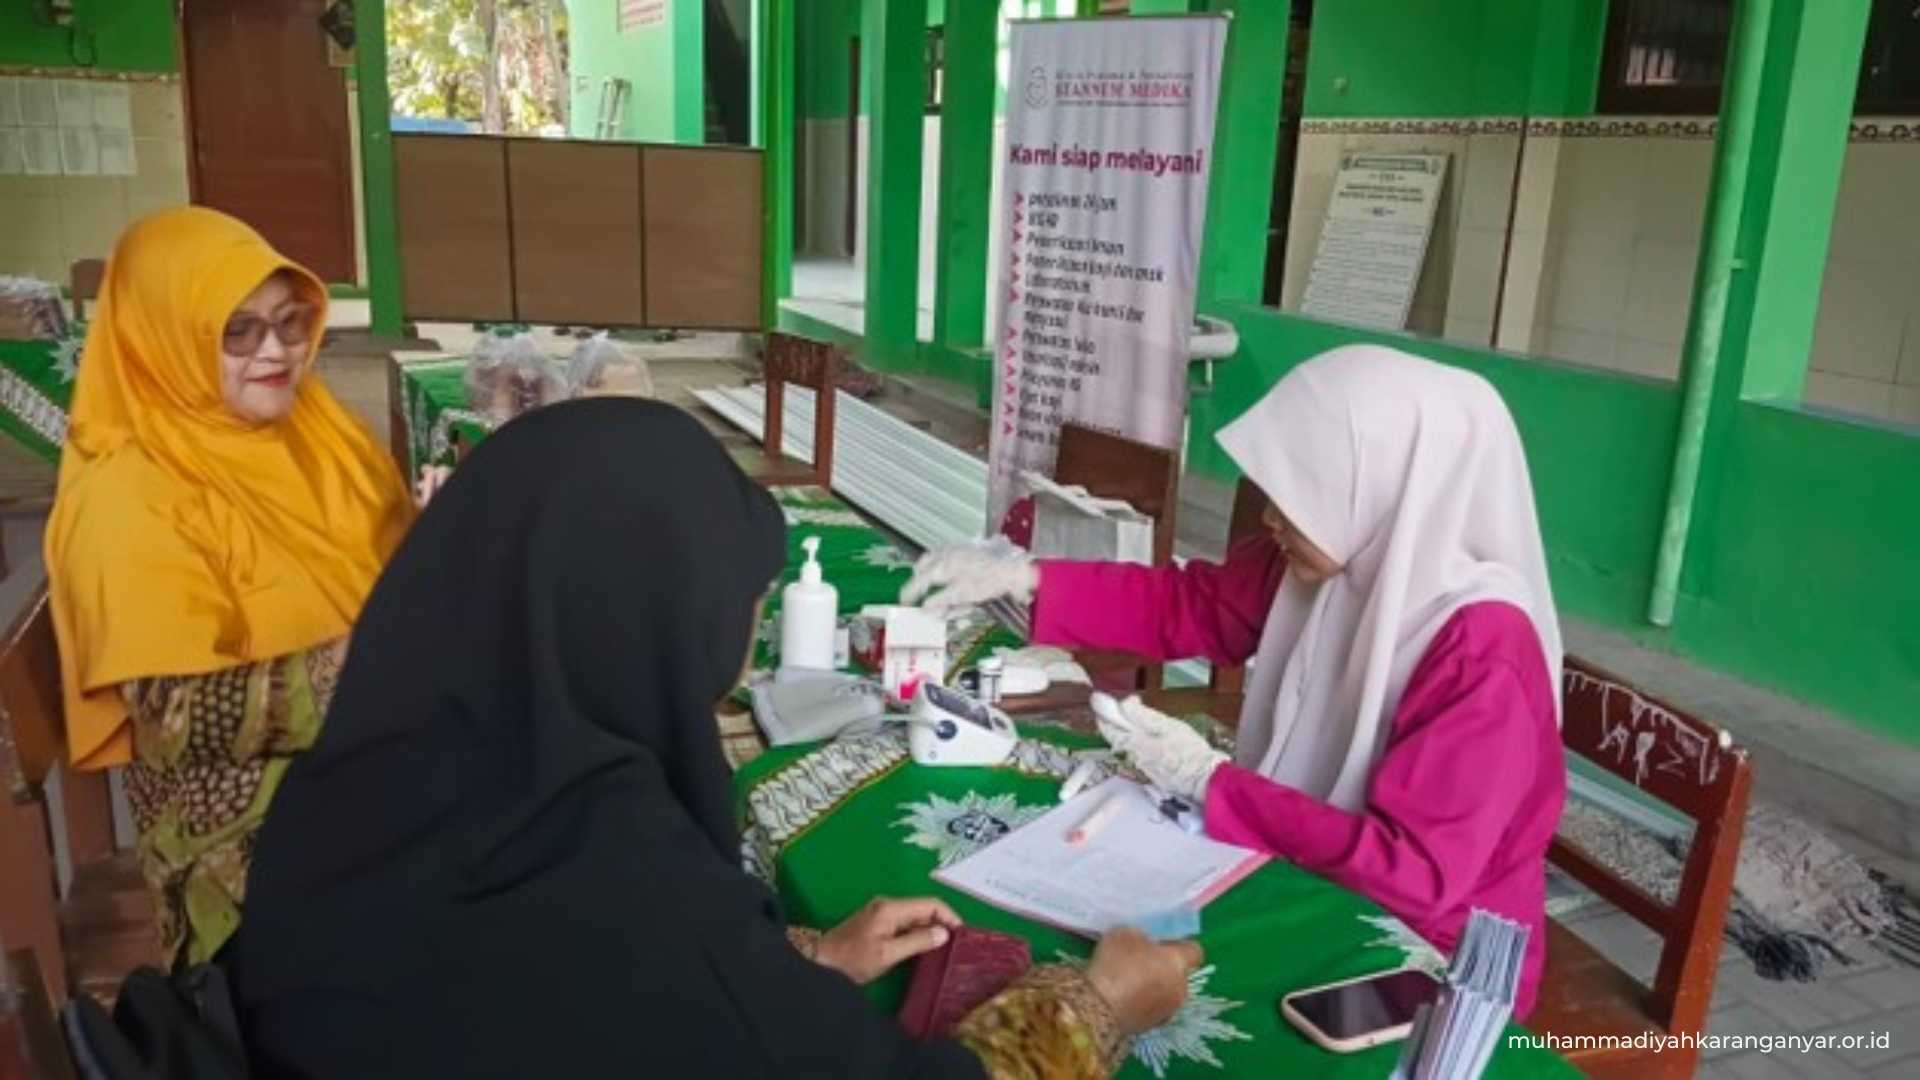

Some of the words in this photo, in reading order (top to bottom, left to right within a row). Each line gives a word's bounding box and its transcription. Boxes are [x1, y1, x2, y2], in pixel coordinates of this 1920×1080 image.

[1009, 143, 1057, 165] Kami
[1061, 145, 1101, 172] siap
[1105, 147, 1204, 176] melayani
